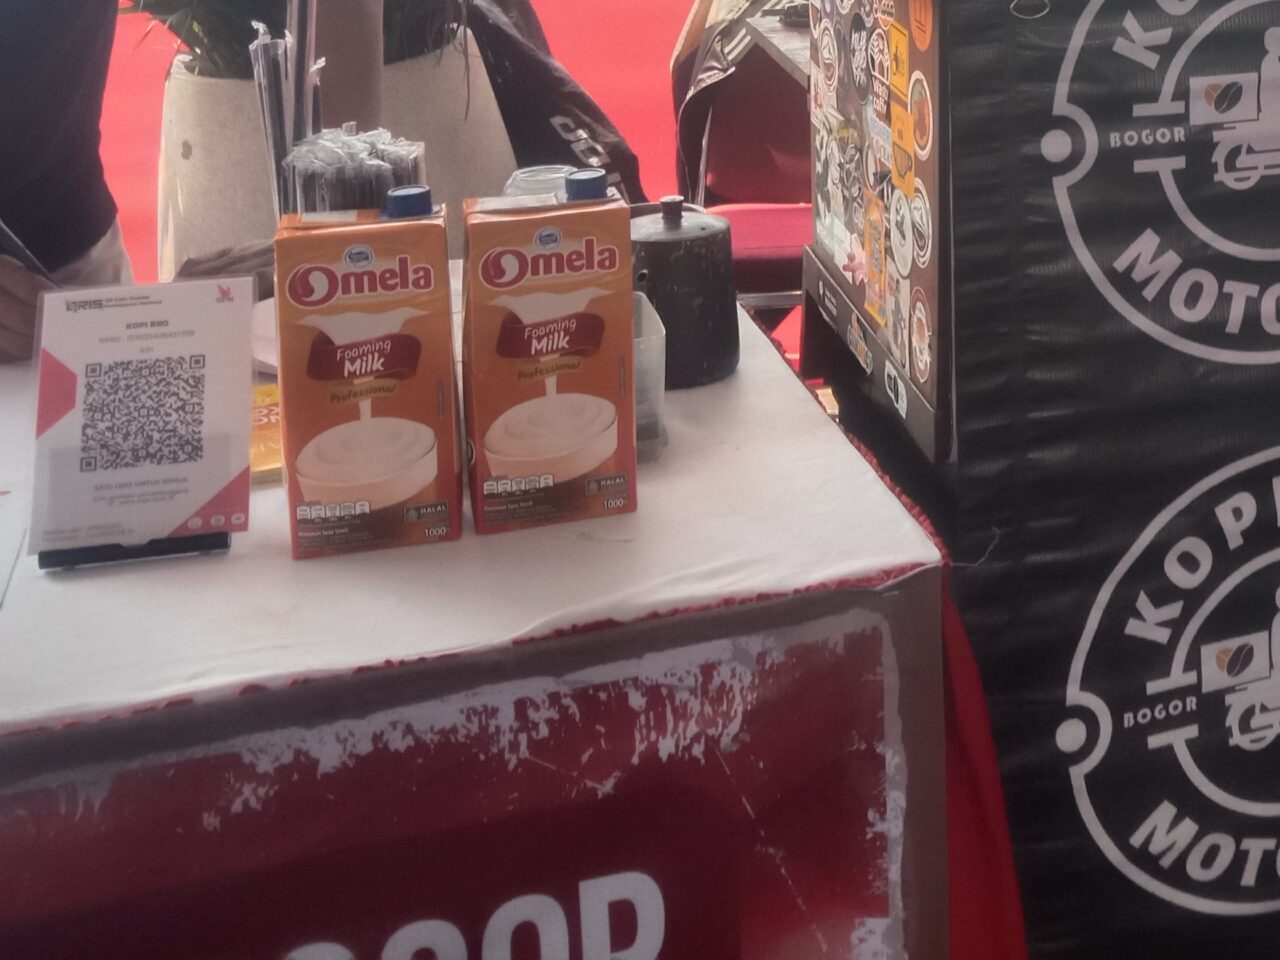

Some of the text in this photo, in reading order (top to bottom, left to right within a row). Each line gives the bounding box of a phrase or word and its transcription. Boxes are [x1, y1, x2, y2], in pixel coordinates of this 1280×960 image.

[1108, 125, 1187, 148] BOGOR
[479, 237, 619, 290] Omela
[287, 254, 434, 308] Omela
[125, 320, 170, 330] KOPI BRO
[524, 318, 577, 340] Foaming
[336, 339, 392, 362] Foaming
[530, 330, 571, 356] Milk
[343, 356, 385, 378] Milk
[517, 361, 581, 381] Professional
[330, 384, 397, 404] Professional
[600, 478, 625, 487] HALAL
[420, 505, 446, 515] HALAL
[603, 498, 624, 509] 1000
[424, 527, 447, 537] 1000
[1123, 695, 1198, 728] BOGOR
